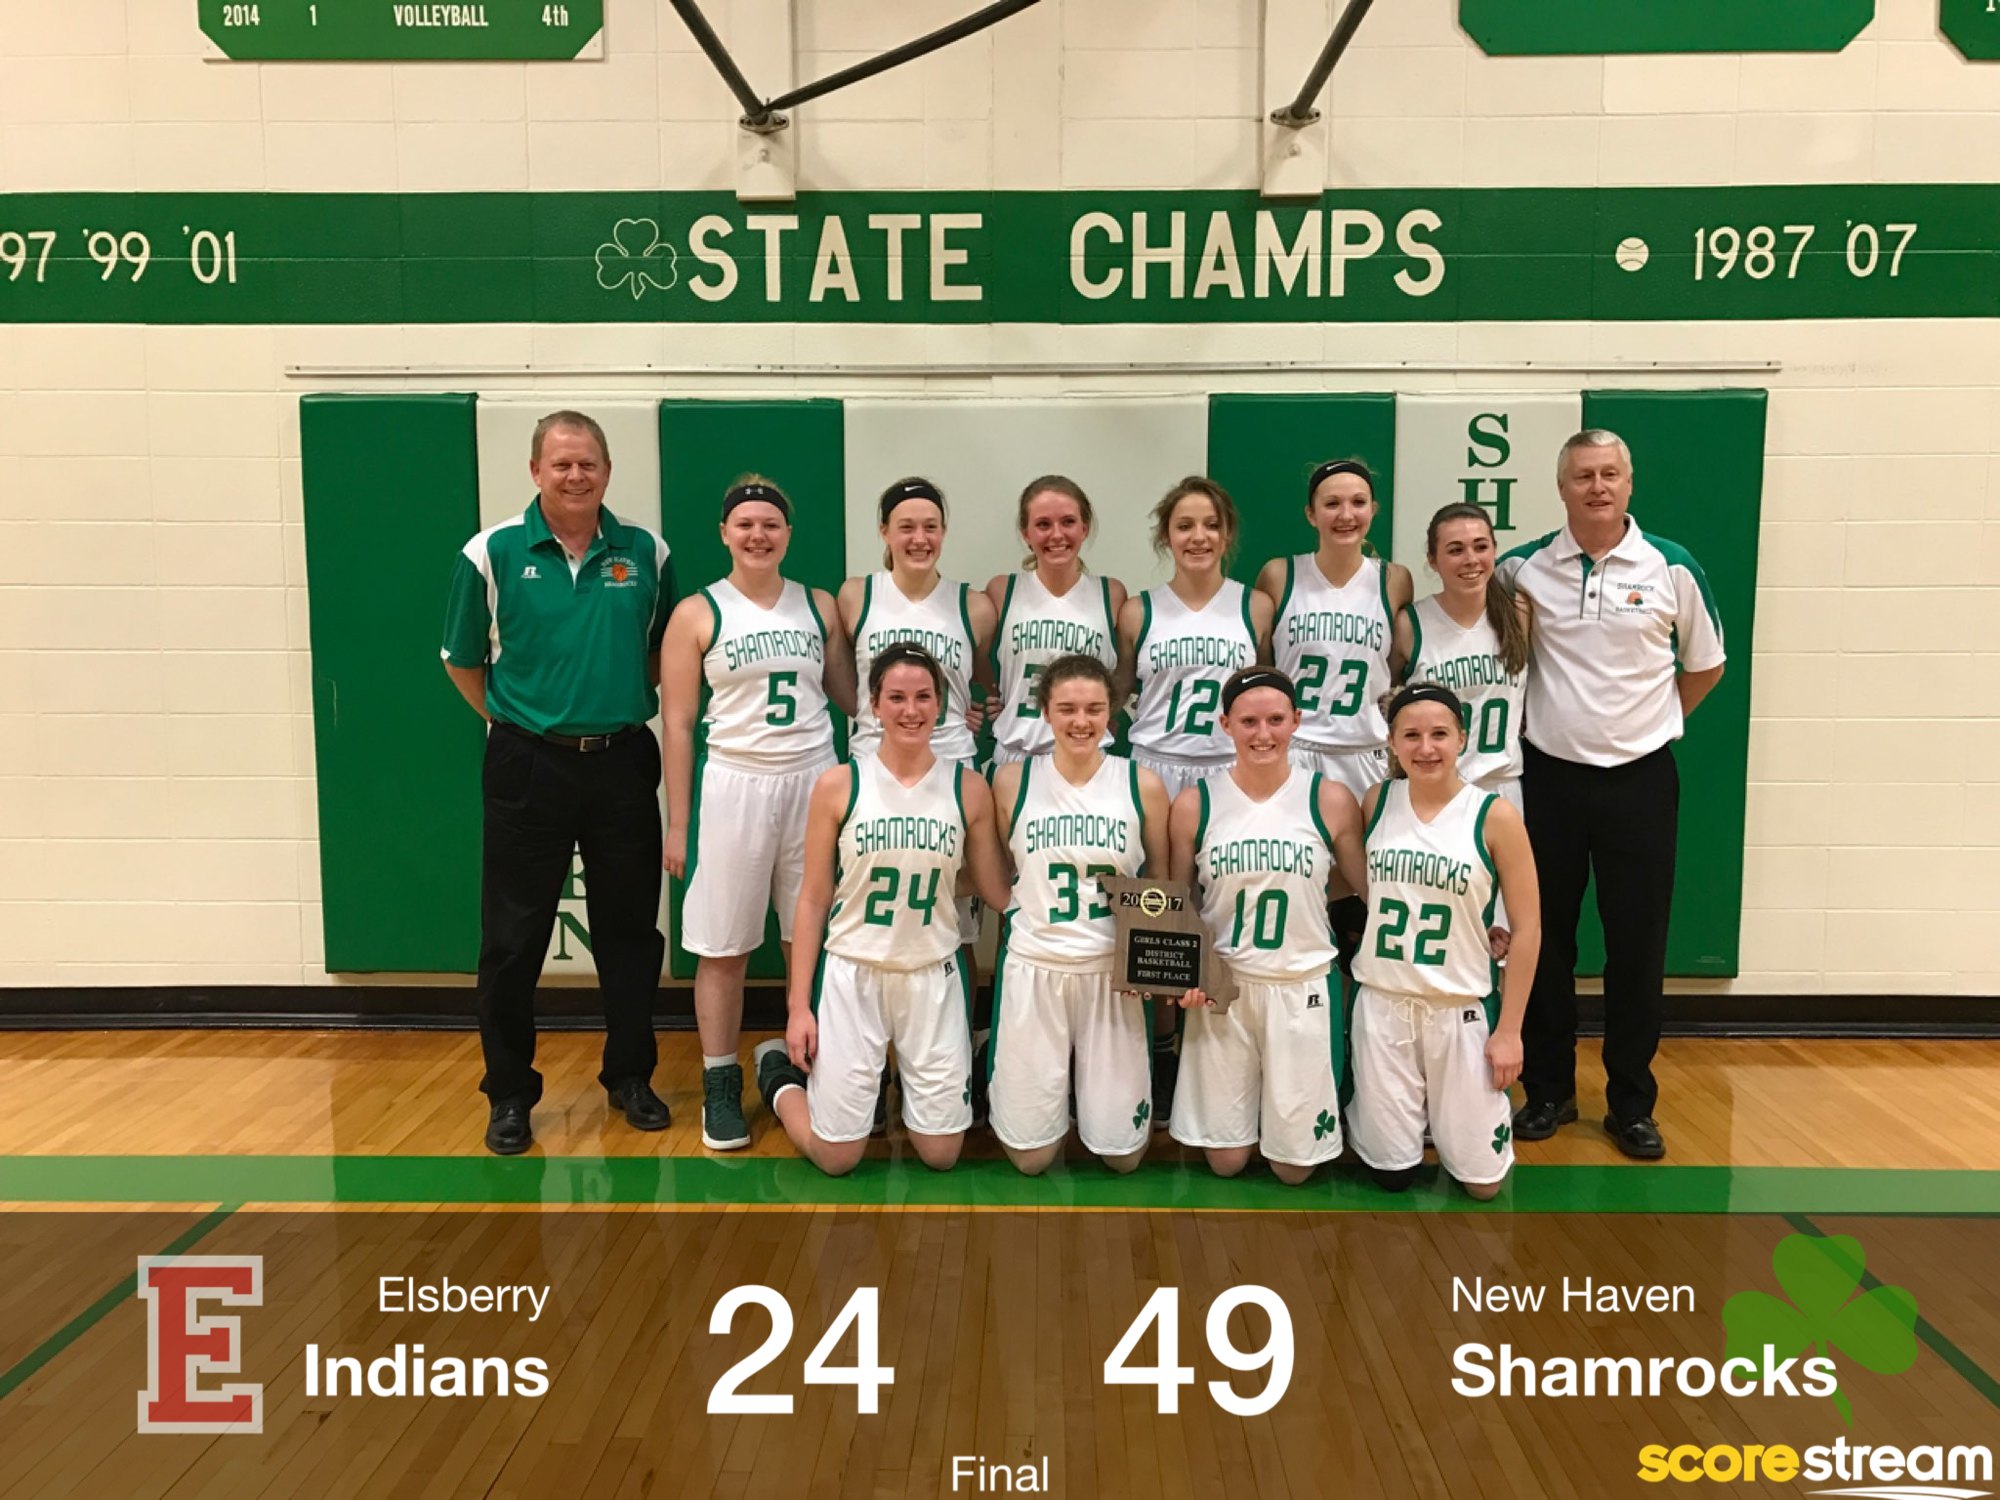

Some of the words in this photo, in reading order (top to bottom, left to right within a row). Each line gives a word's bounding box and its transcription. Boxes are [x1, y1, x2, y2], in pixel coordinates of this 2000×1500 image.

[223, 5, 260, 26] 2014
[310, 5, 317, 26] 1
[394, 5, 489, 27] VOLLEYBALL
[541, 5, 569, 27] 4th
[0, 231, 57, 283] 97
[83, 228, 151, 283] '99
[183, 225, 237, 284] '01
[688, 213, 983, 302] STATE
[1070, 209, 1446, 300] CHAMPS
[1694, 225, 1815, 280] 1987
[1846, 219, 1918, 277] '07
[725, 630, 822, 671] SHAMROCKS
[1012, 619, 1103, 656] SHAMROCKS
[1288, 612, 1384, 652] SHAMROCKS
[1150, 636, 1246, 673] SHAMROCKS
[766, 672, 798, 726] 5
[1295, 655, 1369, 717] 23
[1165, 679, 1221, 736] 12
[855, 816, 957, 857] SHAMROCKS
[1027, 814, 1127, 854] SHAMROCKS
[1210, 839, 1314, 881] SHAMROCKS
[1370, 849, 1472, 896] SHAMROCKS
[863, 866, 941, 927] 24
[1122, 893, 1139, 906] 20
[1168, 898, 1182, 911] 17
[1231, 888, 1289, 950] 10
[1375, 897, 1452, 967] 22
[1134, 935, 1160, 945] GIRLS
[1162, 938, 1190, 947] CLASS
[1145, 949, 1184, 960] DISTRICT
[1137, 957, 1192, 968] BASKETBALL
[1137, 970, 1160, 979] FIRST
[1163, 971, 1191, 981] PLACE
